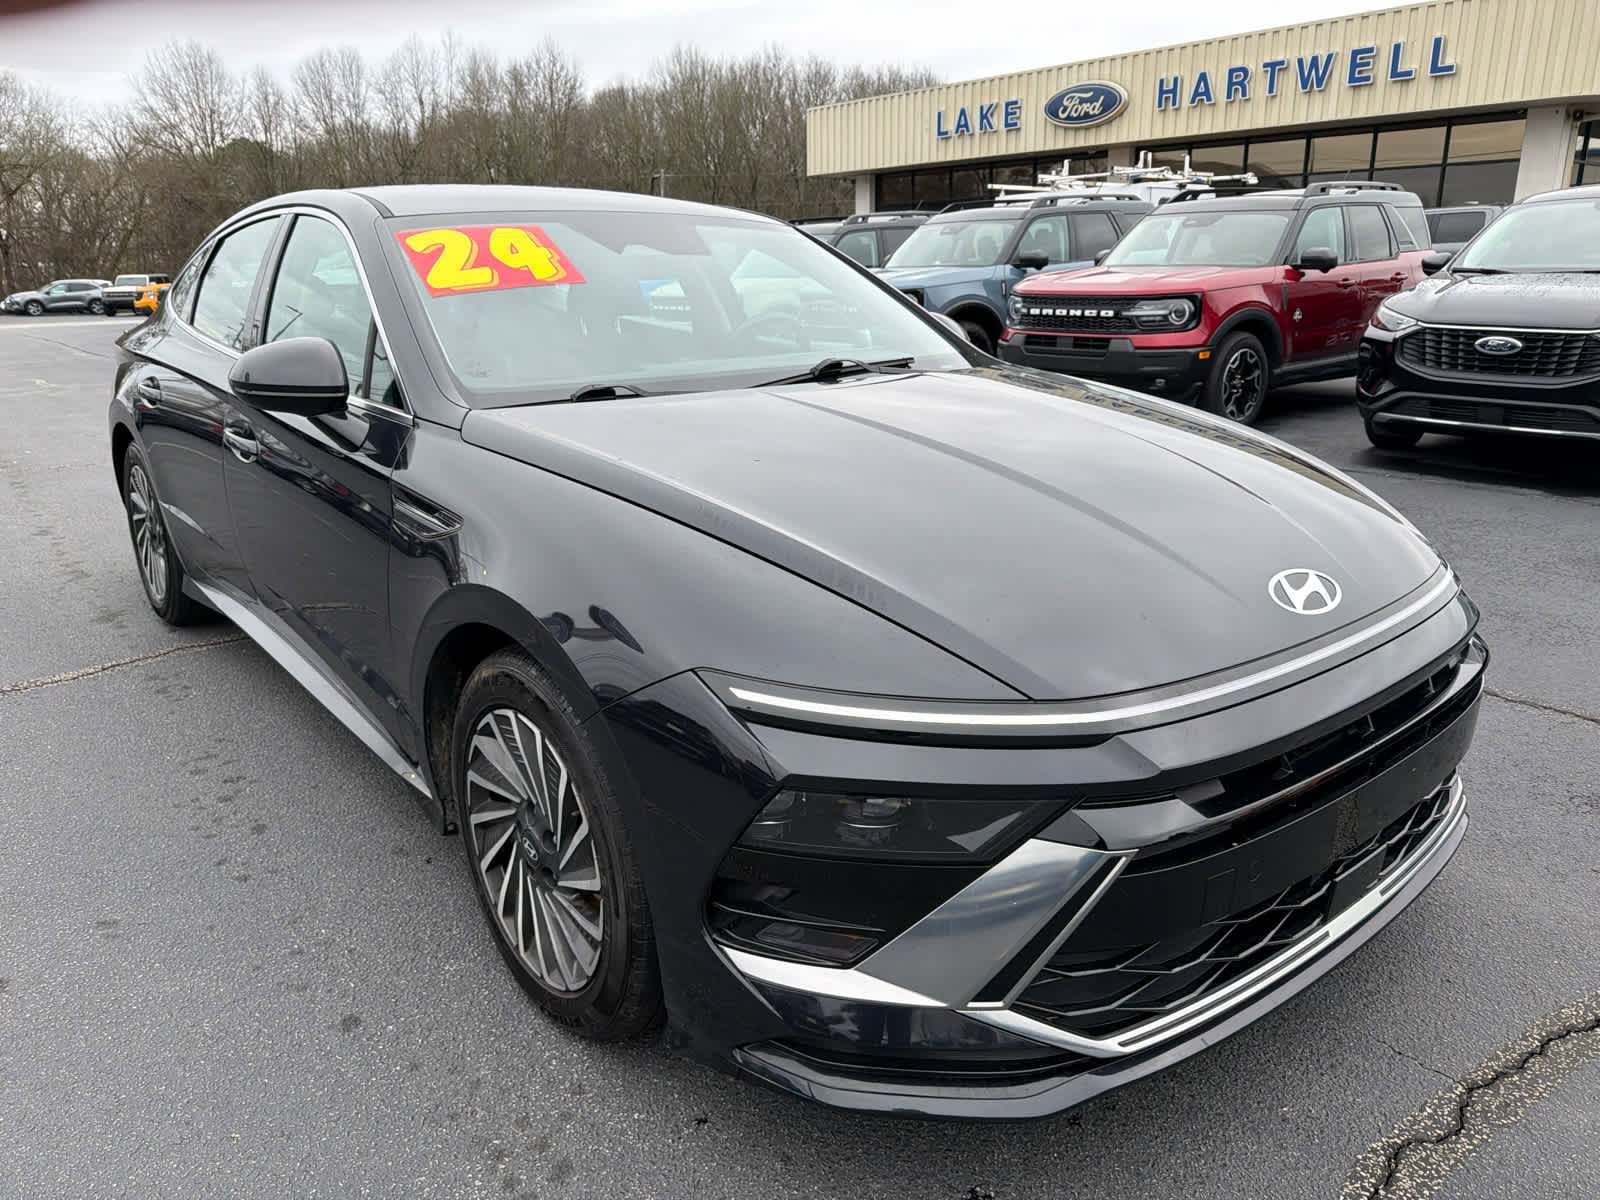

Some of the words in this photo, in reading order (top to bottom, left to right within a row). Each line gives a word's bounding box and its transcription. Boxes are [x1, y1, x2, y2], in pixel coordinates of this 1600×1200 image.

[936, 99, 1022, 139] LAKE
[1157, 35, 1456, 111] HARTWELL
[1058, 91, 1105, 119] Ford
[405, 228, 567, 290] 24
[1030, 308, 1114, 317] BRONCO
